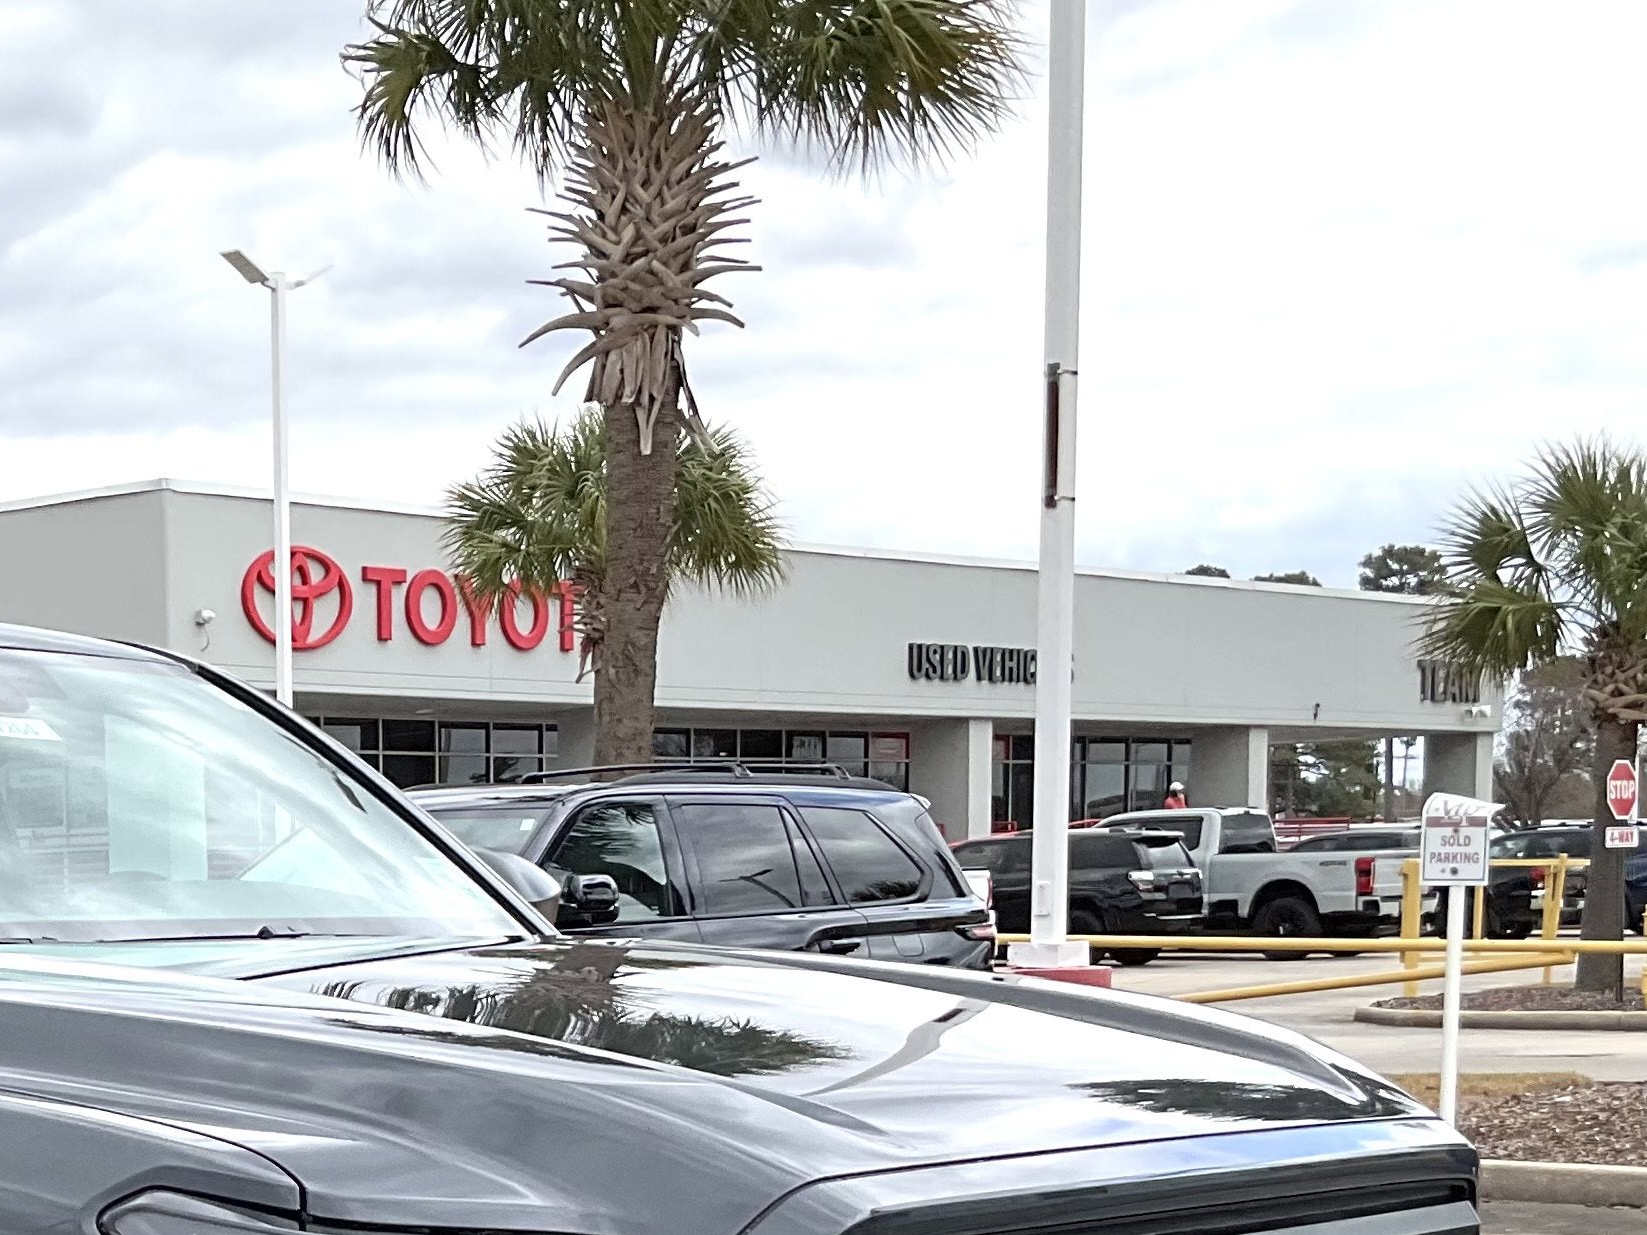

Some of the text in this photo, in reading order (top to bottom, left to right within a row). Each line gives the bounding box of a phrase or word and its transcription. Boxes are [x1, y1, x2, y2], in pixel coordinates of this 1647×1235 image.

[362, 566, 590, 651] TOYOT
[908, 642, 1074, 684] USED VEHIC
[1609, 780, 1635, 800] STOP
[1440, 835, 1472, 847] SOLD
[1609, 830, 1635, 844] 4-WAY
[1429, 851, 1480, 864] PARKING
